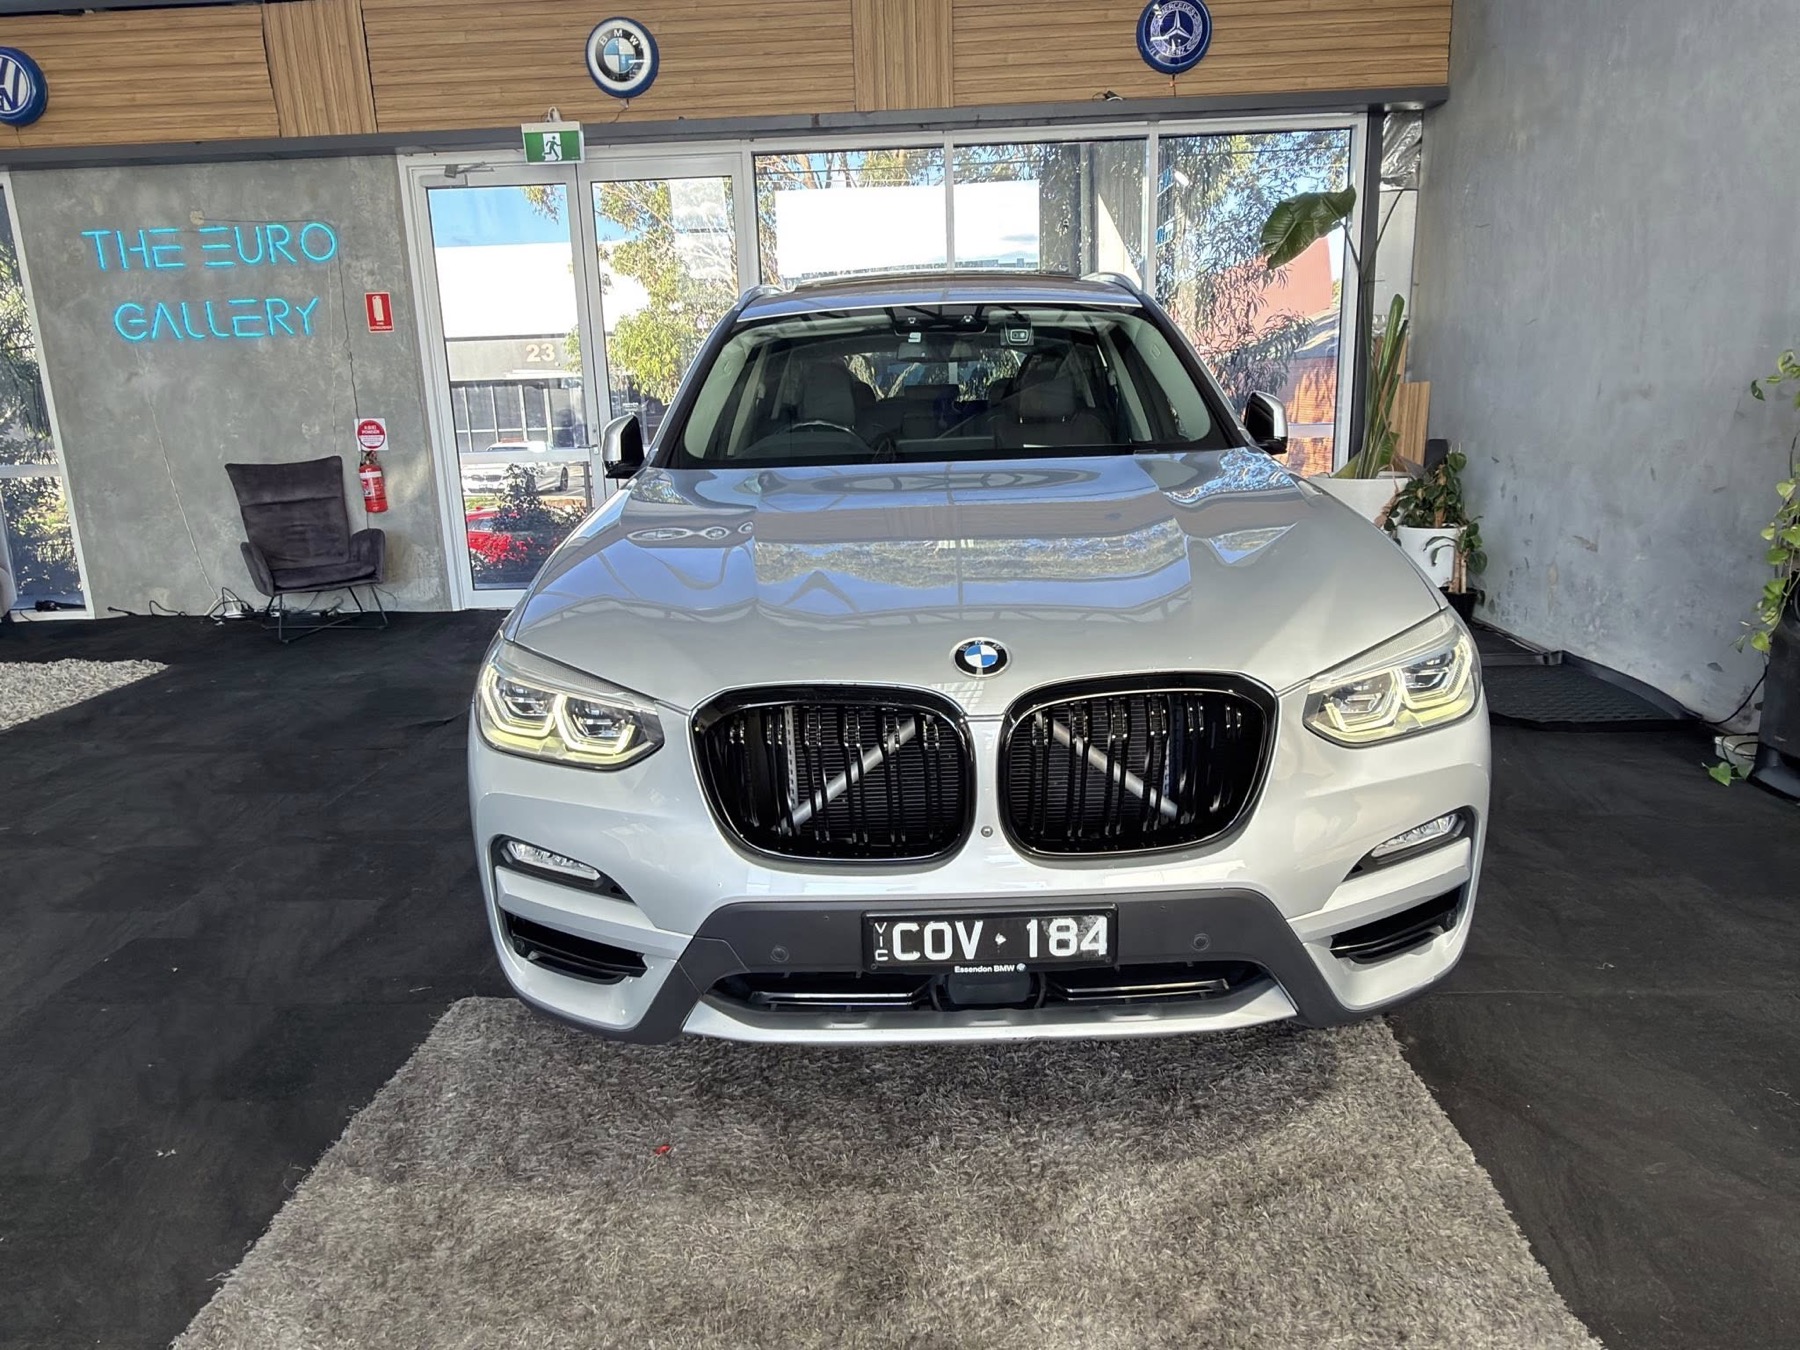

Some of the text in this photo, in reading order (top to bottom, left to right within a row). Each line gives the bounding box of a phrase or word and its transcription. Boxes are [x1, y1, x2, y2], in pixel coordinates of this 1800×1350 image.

[599, 29, 639, 46] BMW
[82, 222, 337, 270] THE EURO
[114, 297, 319, 342] GALLERY
[526, 343, 555, 361] 23
[960, 640, 1003, 651] BMW
[875, 922, 888, 961] VIC
[892, 916, 1108, 961] COV 184
[954, 964, 1015, 973] Essendon BMW
